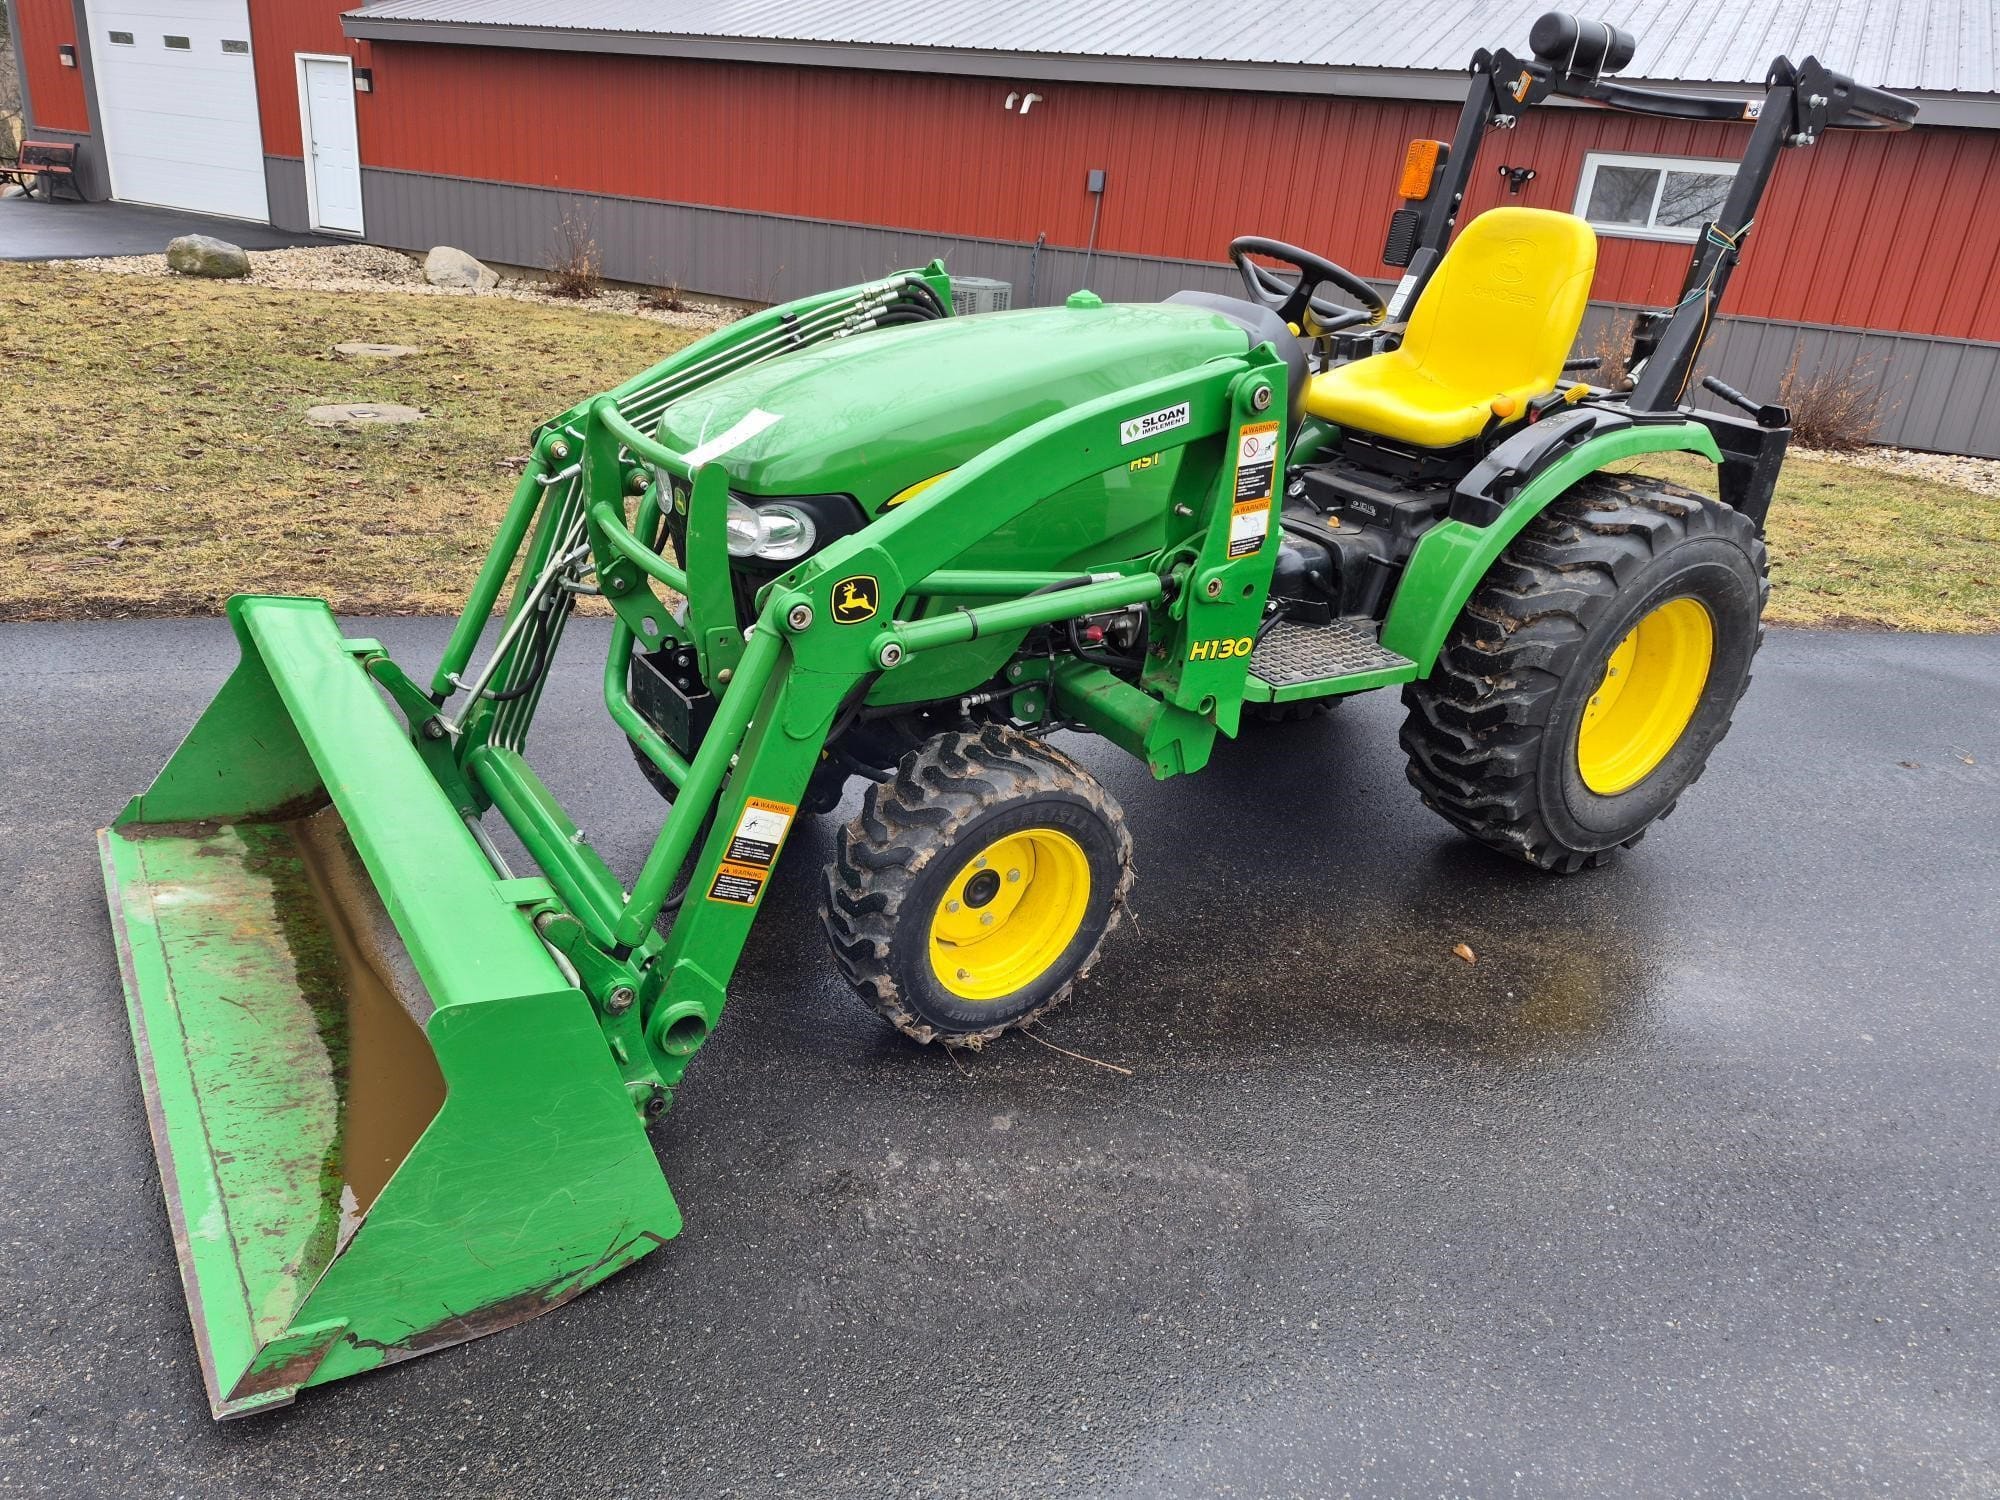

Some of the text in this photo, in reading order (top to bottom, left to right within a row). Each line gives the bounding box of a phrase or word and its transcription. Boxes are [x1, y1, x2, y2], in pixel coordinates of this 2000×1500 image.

[1142, 406, 1185, 428] SLOAN
[1142, 416, 1185, 435] IMPLEMENT
[1248, 422, 1278, 432] WARNING
[1241, 501, 1269, 511] WARNING
[1189, 636, 1253, 661] H130
[760, 802, 790, 813] WARNING
[732, 868, 763, 879] WARNING
